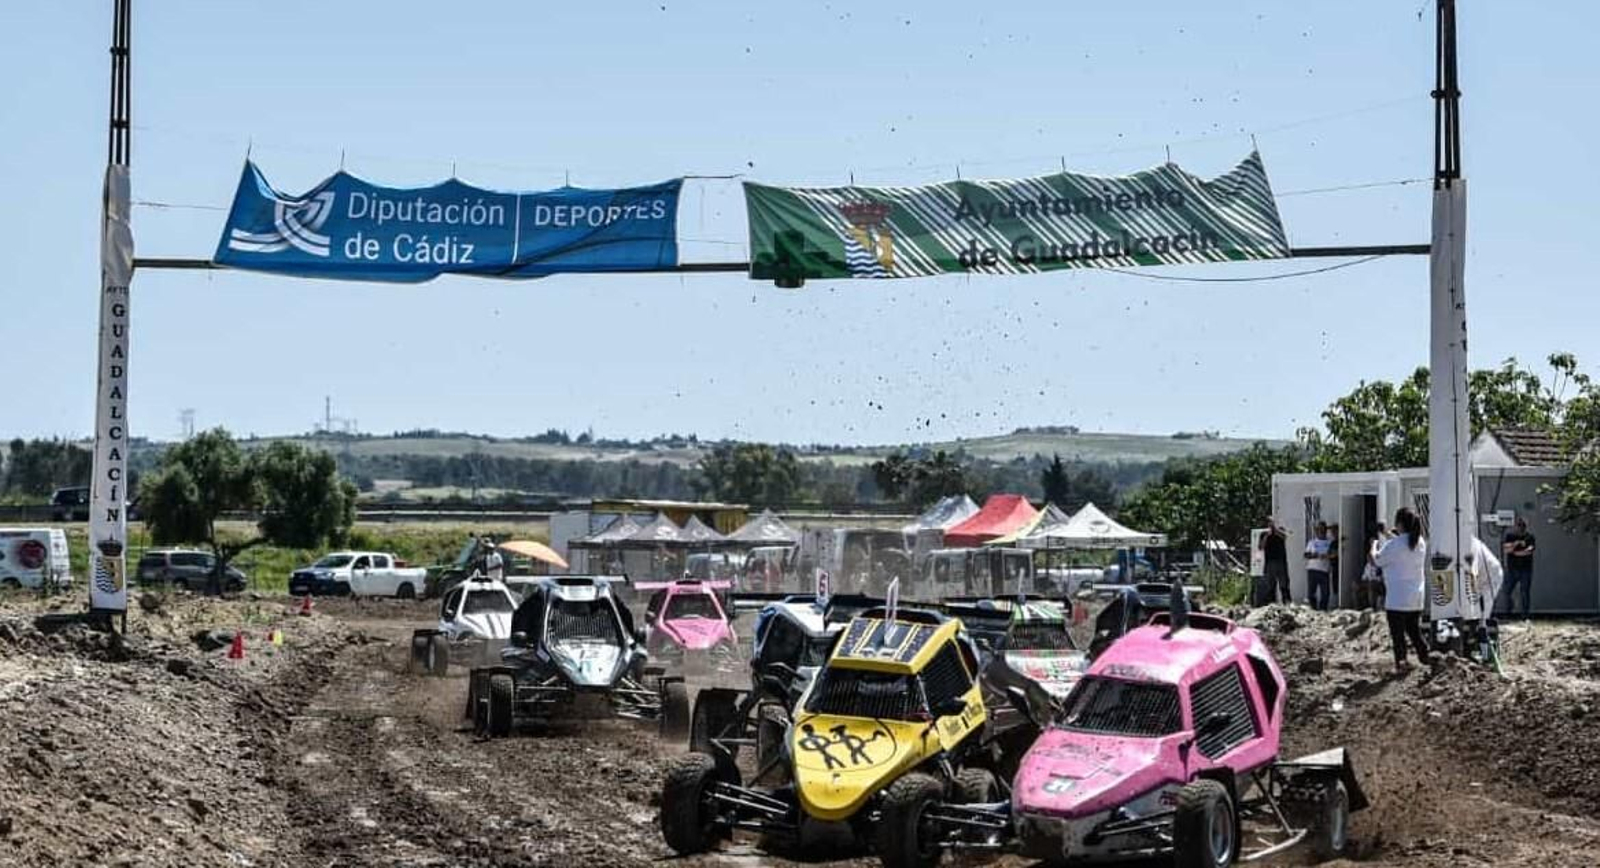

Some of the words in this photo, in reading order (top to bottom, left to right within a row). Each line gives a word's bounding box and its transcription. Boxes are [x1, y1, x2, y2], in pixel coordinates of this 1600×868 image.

[347, 191, 505, 226] Diputación
[534, 199, 667, 227] DEPORTES
[954, 183, 1186, 228] Ayuntamiento
[344, 231, 381, 260] de
[392, 233, 475, 264] Cádiz
[958, 239, 998, 268] de
[107, 302, 126, 522] GUADALCACÍN
